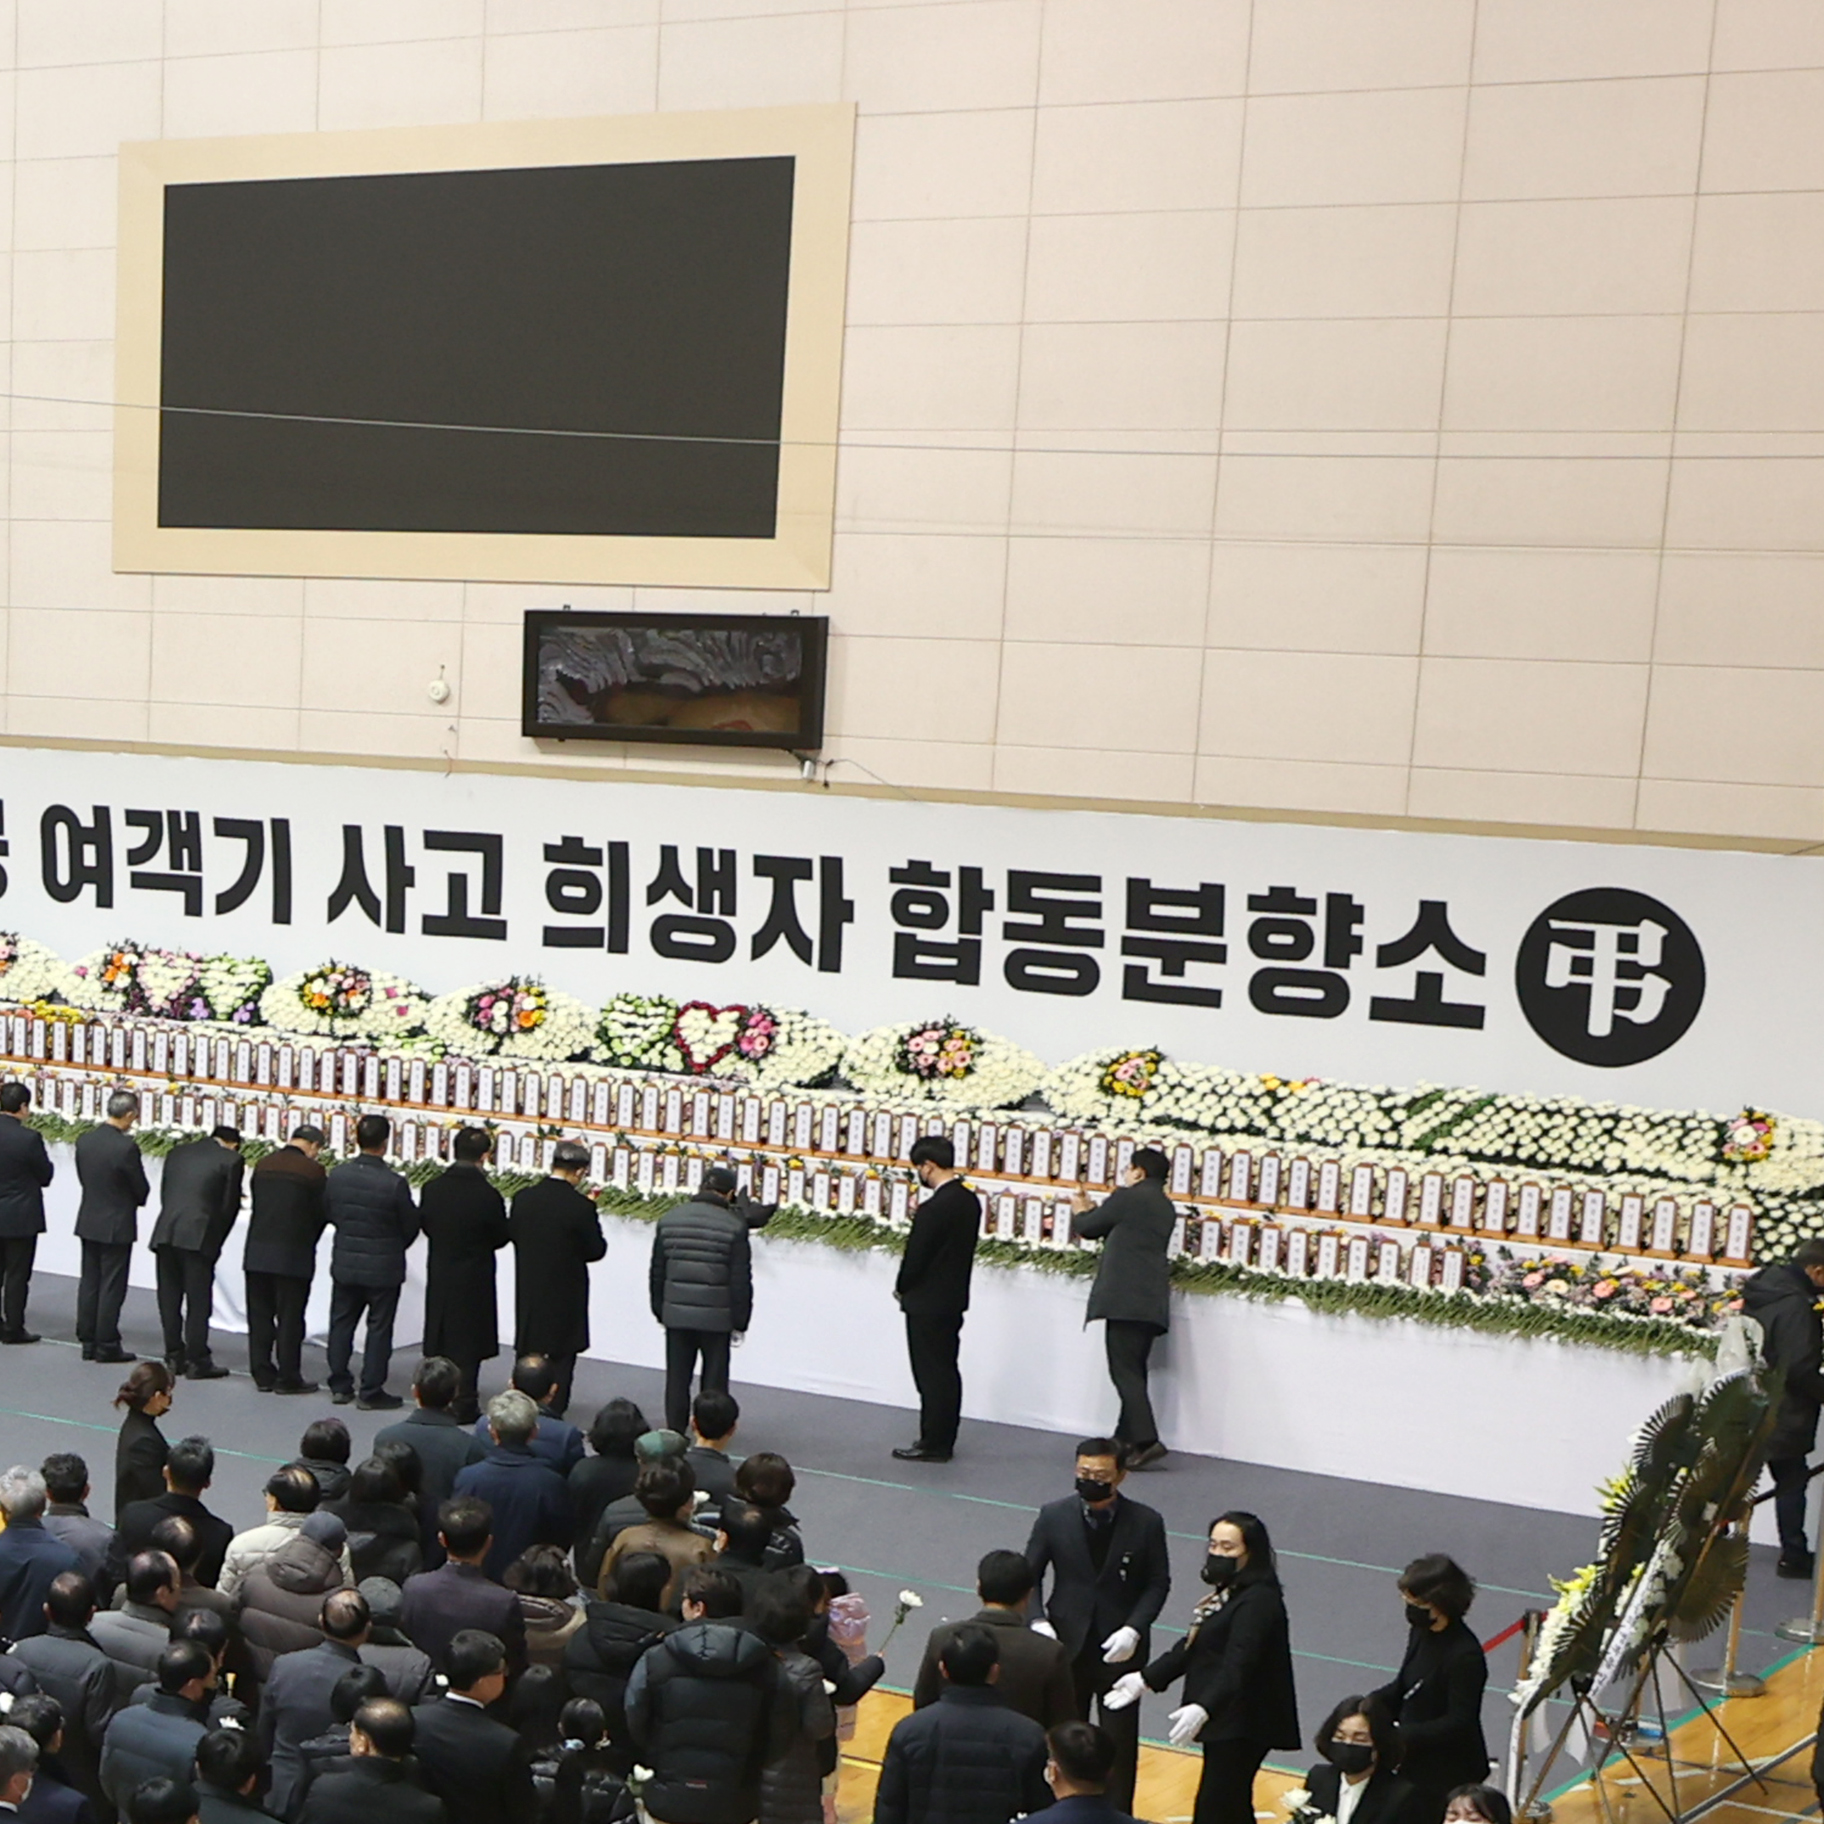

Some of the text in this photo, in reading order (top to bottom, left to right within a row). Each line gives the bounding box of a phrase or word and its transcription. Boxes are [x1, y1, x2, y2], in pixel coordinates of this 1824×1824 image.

[41, 805, 292, 925] 여객기
[328, 826, 507, 941] 사고
[543, 837, 854, 973] 희생자
[890, 860, 1486, 1030] 합동분향소
[1547, 915, 1670, 1038] 弔
